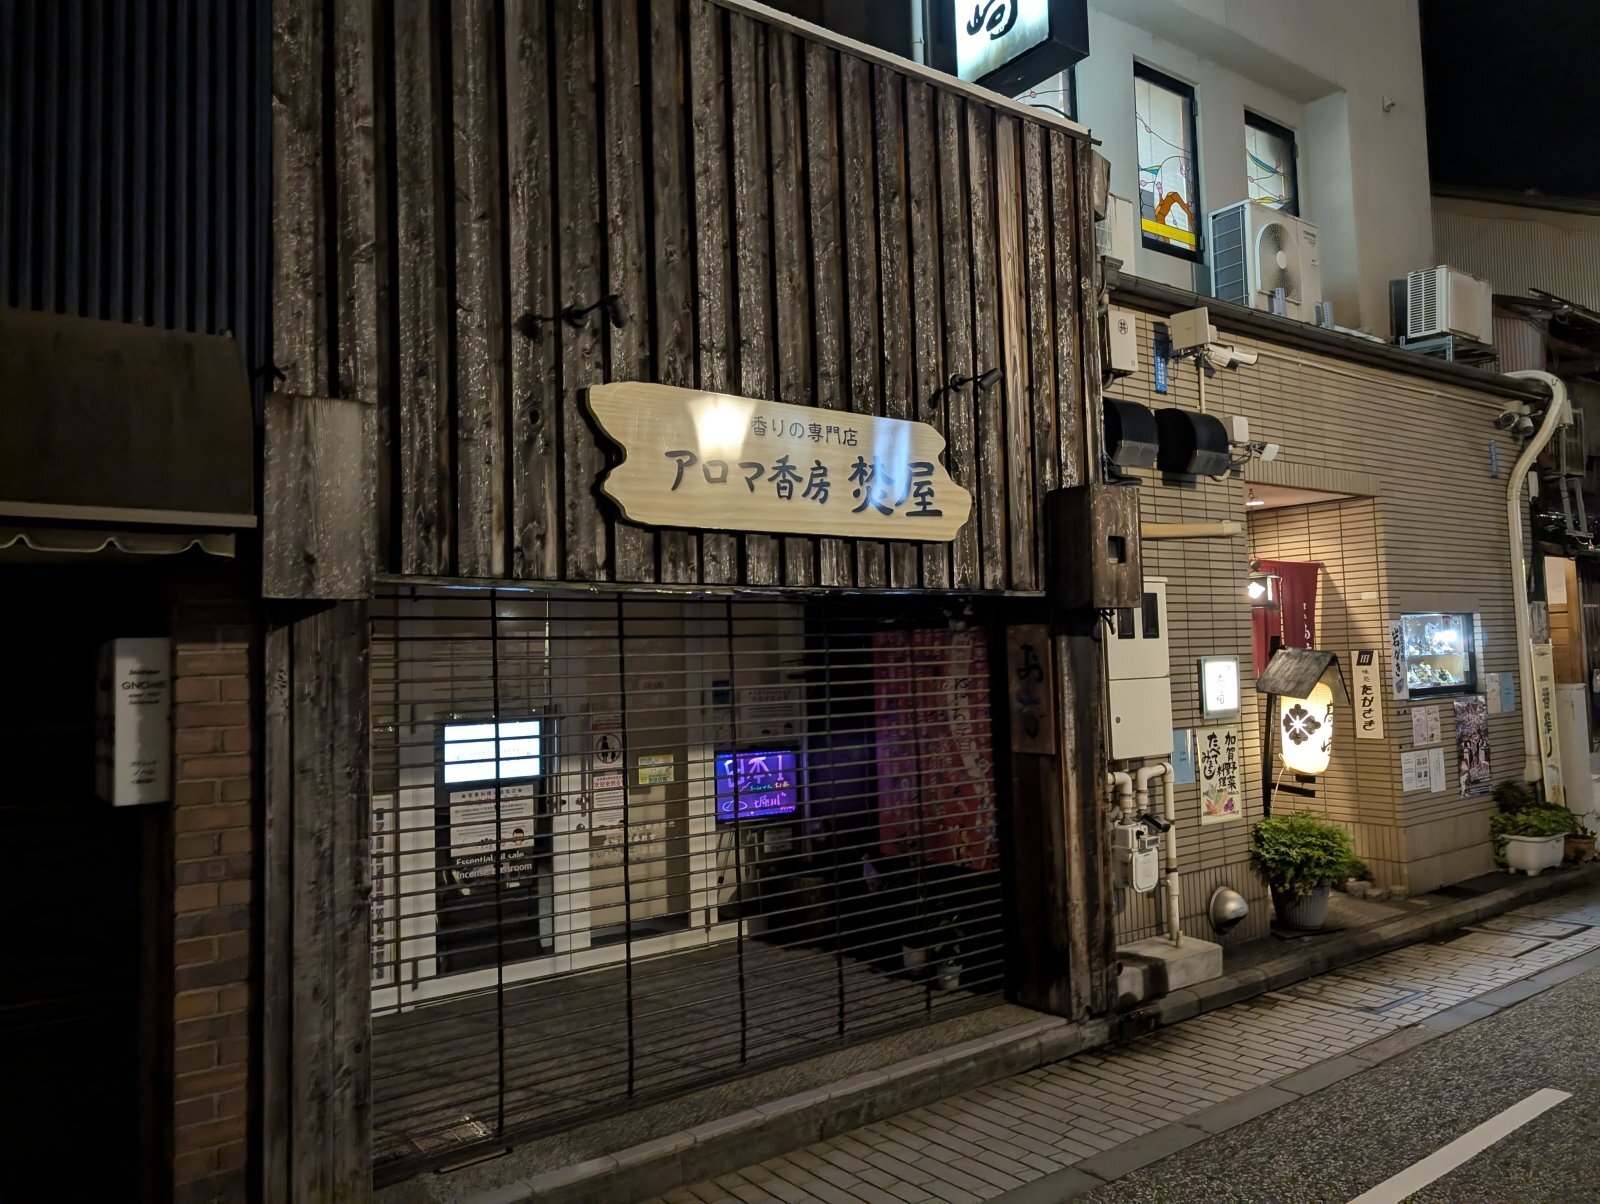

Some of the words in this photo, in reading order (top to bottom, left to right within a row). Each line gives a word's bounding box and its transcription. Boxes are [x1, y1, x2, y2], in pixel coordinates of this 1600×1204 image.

[751, 416, 858, 446] 香りの専門店
[665, 451, 831, 505] アロマ香房
[848, 456, 943, 517] 焚屋
[1225, 731, 1237, 790] 加賀野菜
